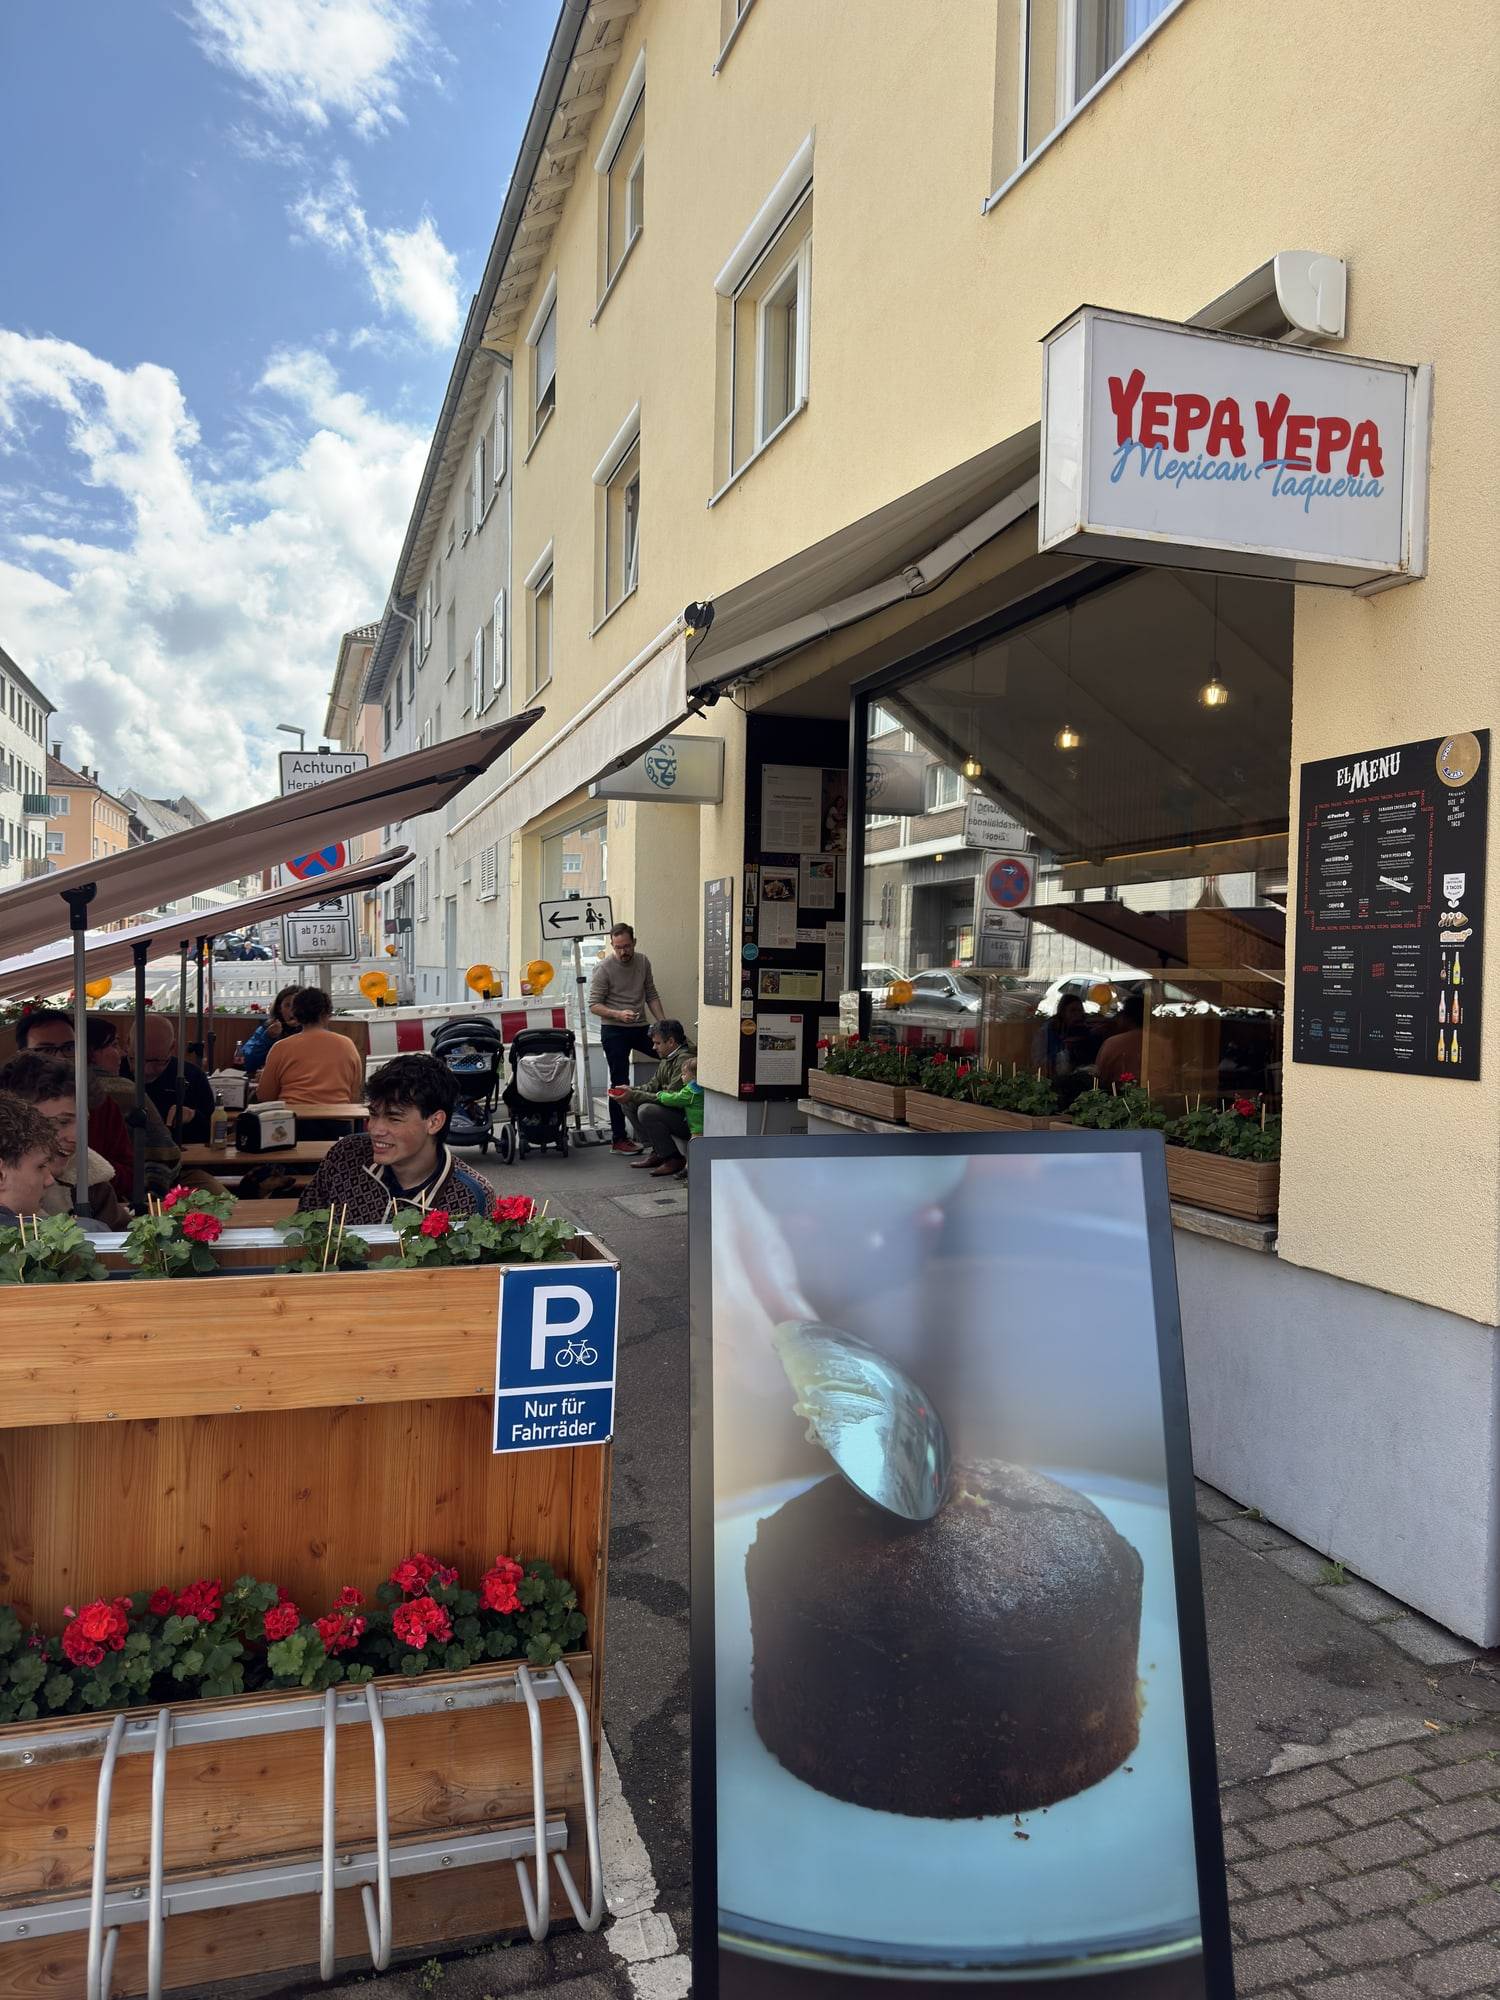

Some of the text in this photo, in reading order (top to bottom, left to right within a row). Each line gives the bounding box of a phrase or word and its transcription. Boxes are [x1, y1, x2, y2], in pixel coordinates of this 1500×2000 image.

[1108, 368, 1384, 478] YEPA YEPA
[1110, 437, 1252, 489] Mexican
[1336, 752, 1400, 793] EL MENU
[302, 924, 335, 934] ab 7.5.26
[530, 1285, 594, 1370] P
[525, 1398, 586, 1419] Nur für
[512, 1420, 596, 1442] Fahrräder
